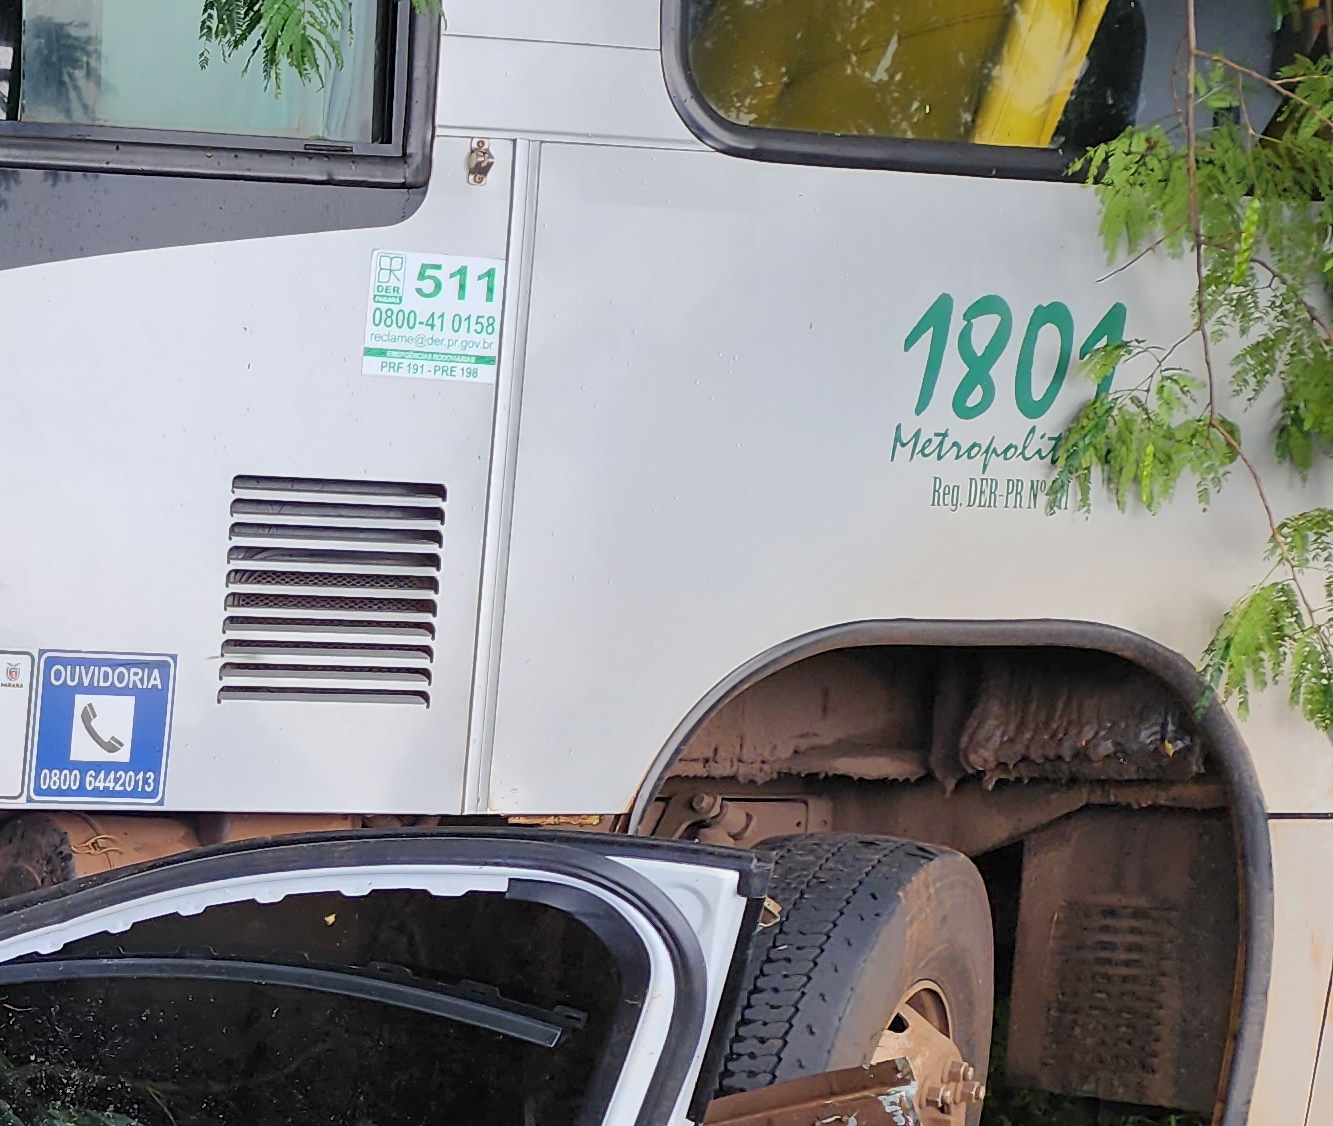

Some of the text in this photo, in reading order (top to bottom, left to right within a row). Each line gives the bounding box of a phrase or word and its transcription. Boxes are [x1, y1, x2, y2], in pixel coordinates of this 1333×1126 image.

[376, 285, 401, 295] DER
[415, 263, 496, 302] 511
[372, 307, 496, 336] 0800-41 0158
[370, 332, 494, 350] reclame@der.pr.gov.br
[380, 361, 404, 373] PRF
[406, 364, 425, 375] 191
[433, 365, 457, 378] PRE
[460, 367, 479, 379] 198
[930, 476, 963, 512] Reg.
[967, 477, 1024, 510] DER-PR
[49, 664, 162, 690] OUVIDORIA
[40, 768, 155, 793] 0800 6442013
